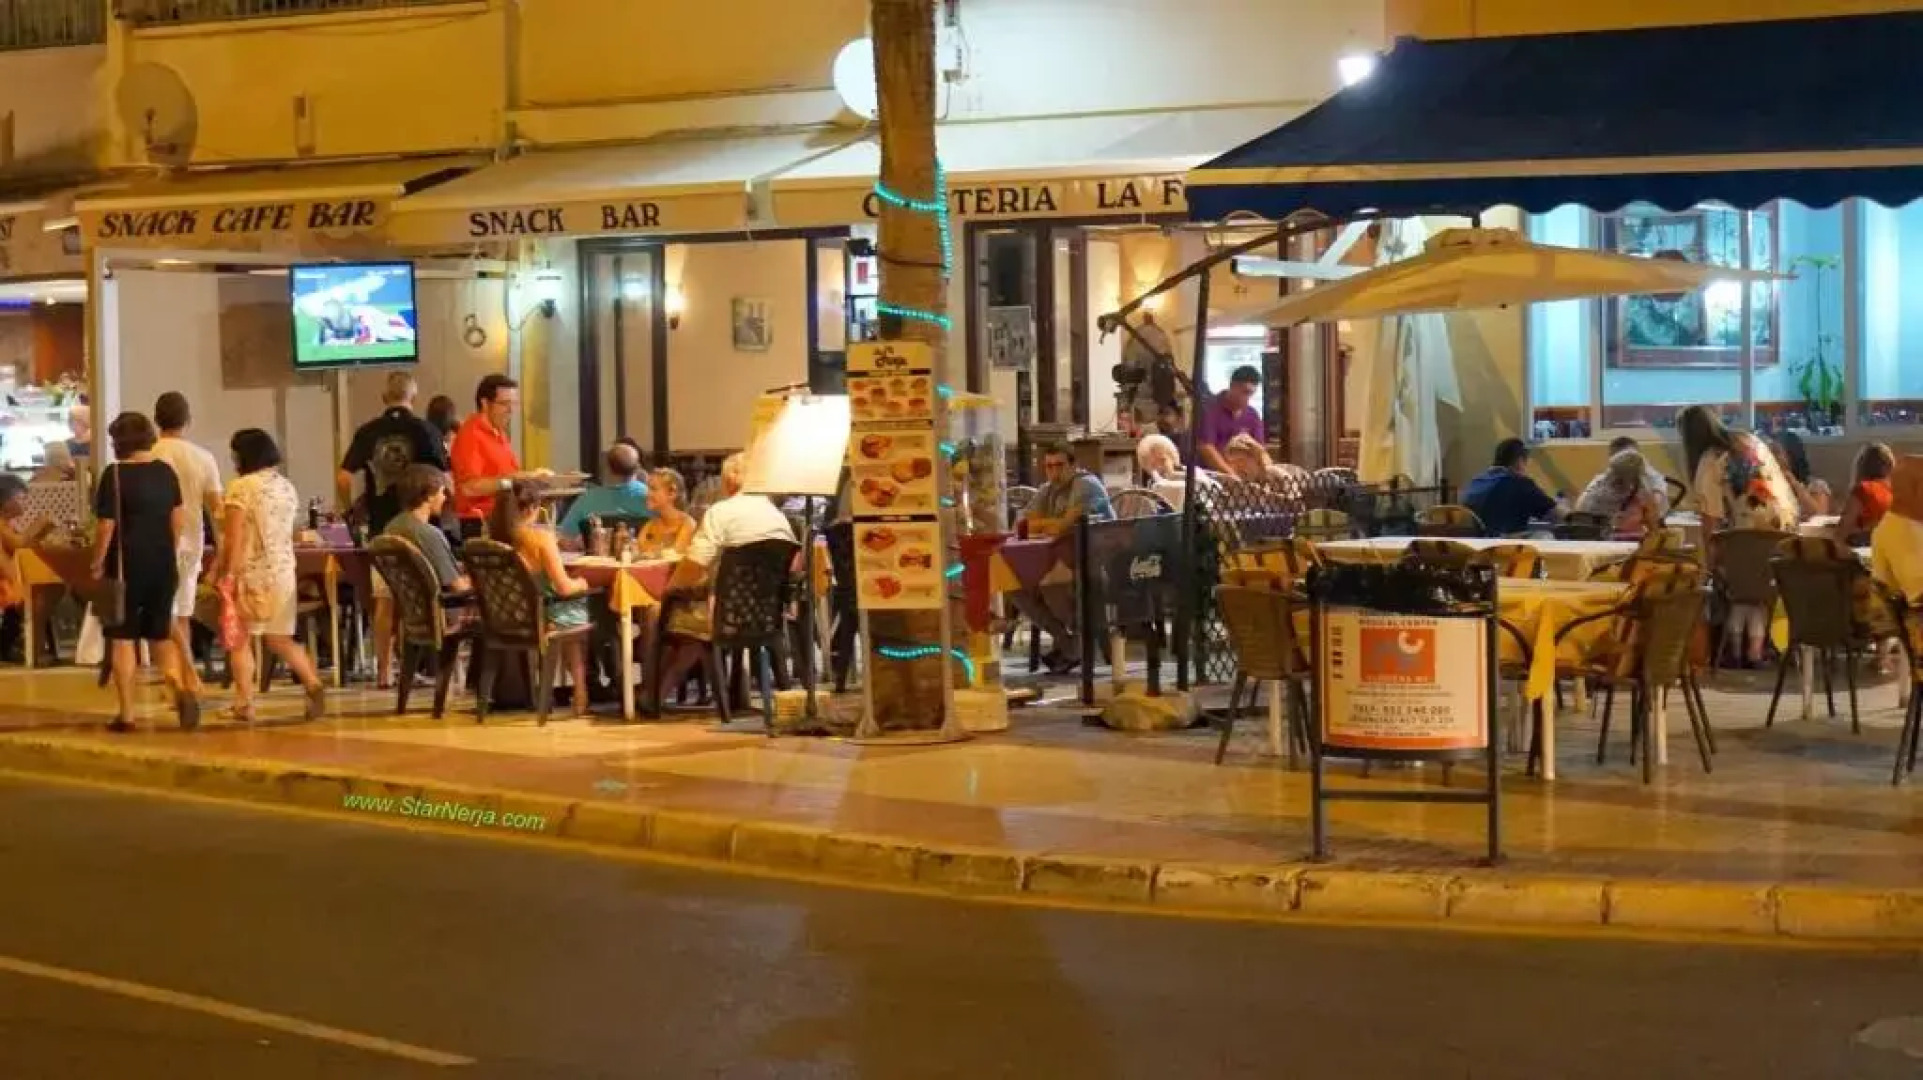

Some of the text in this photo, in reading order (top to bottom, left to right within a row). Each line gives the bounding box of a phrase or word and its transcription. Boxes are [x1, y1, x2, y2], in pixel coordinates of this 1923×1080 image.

[862, 186, 1056, 218] CTERIA
[1096, 181, 1142, 209] LA
[99, 199, 376, 238] SNACK CAFE BAR
[468, 202, 661, 238] SNACK BAR
